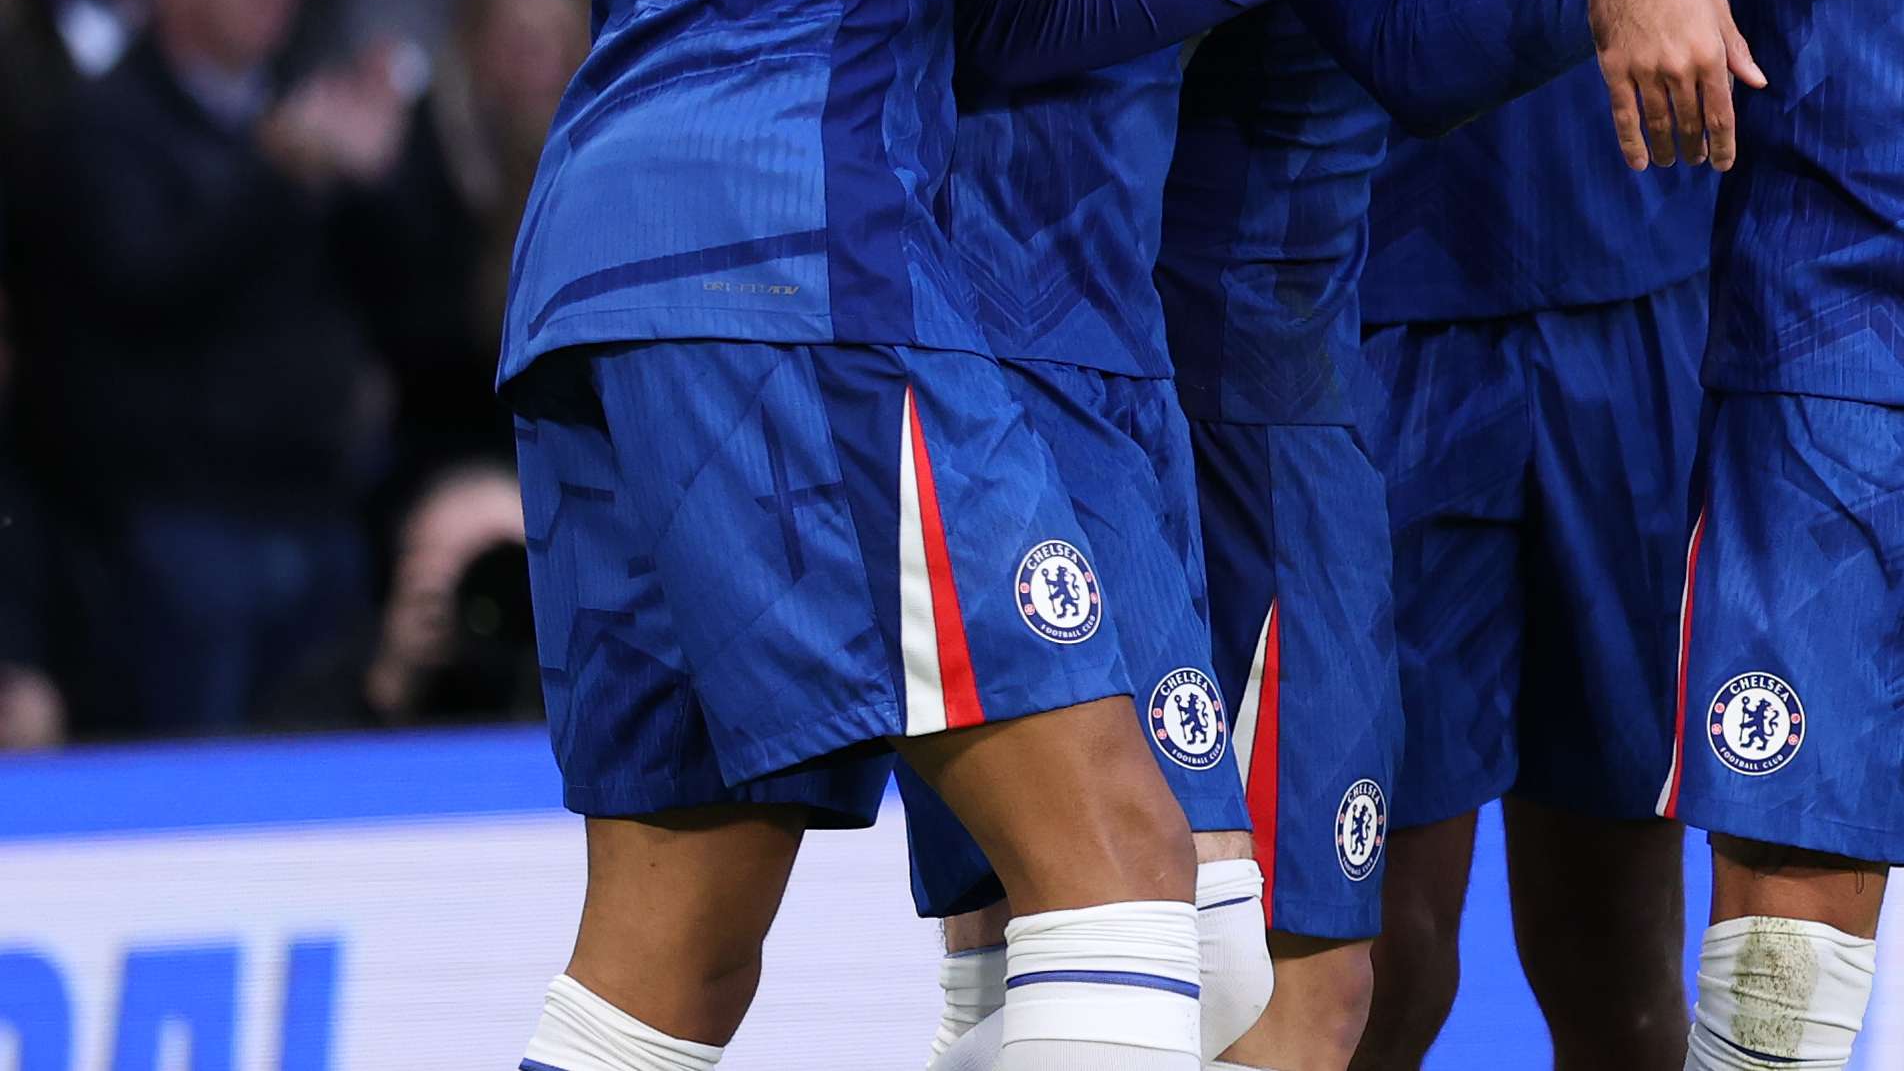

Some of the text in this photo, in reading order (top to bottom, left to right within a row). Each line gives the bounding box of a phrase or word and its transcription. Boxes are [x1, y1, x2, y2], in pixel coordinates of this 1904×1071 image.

[1026, 544, 1078, 570] CHELSEA
[1041, 615, 1096, 638] FOOTBALL CLUB
[1160, 672, 1208, 696] CHELSEA
[1729, 676, 1790, 702] CHELSEA
[1172, 749, 1208, 764] FOOTBALL
[1720, 747, 1784, 770] FOOTBALL CLUB
[1347, 783, 1381, 805] CHELSEA
